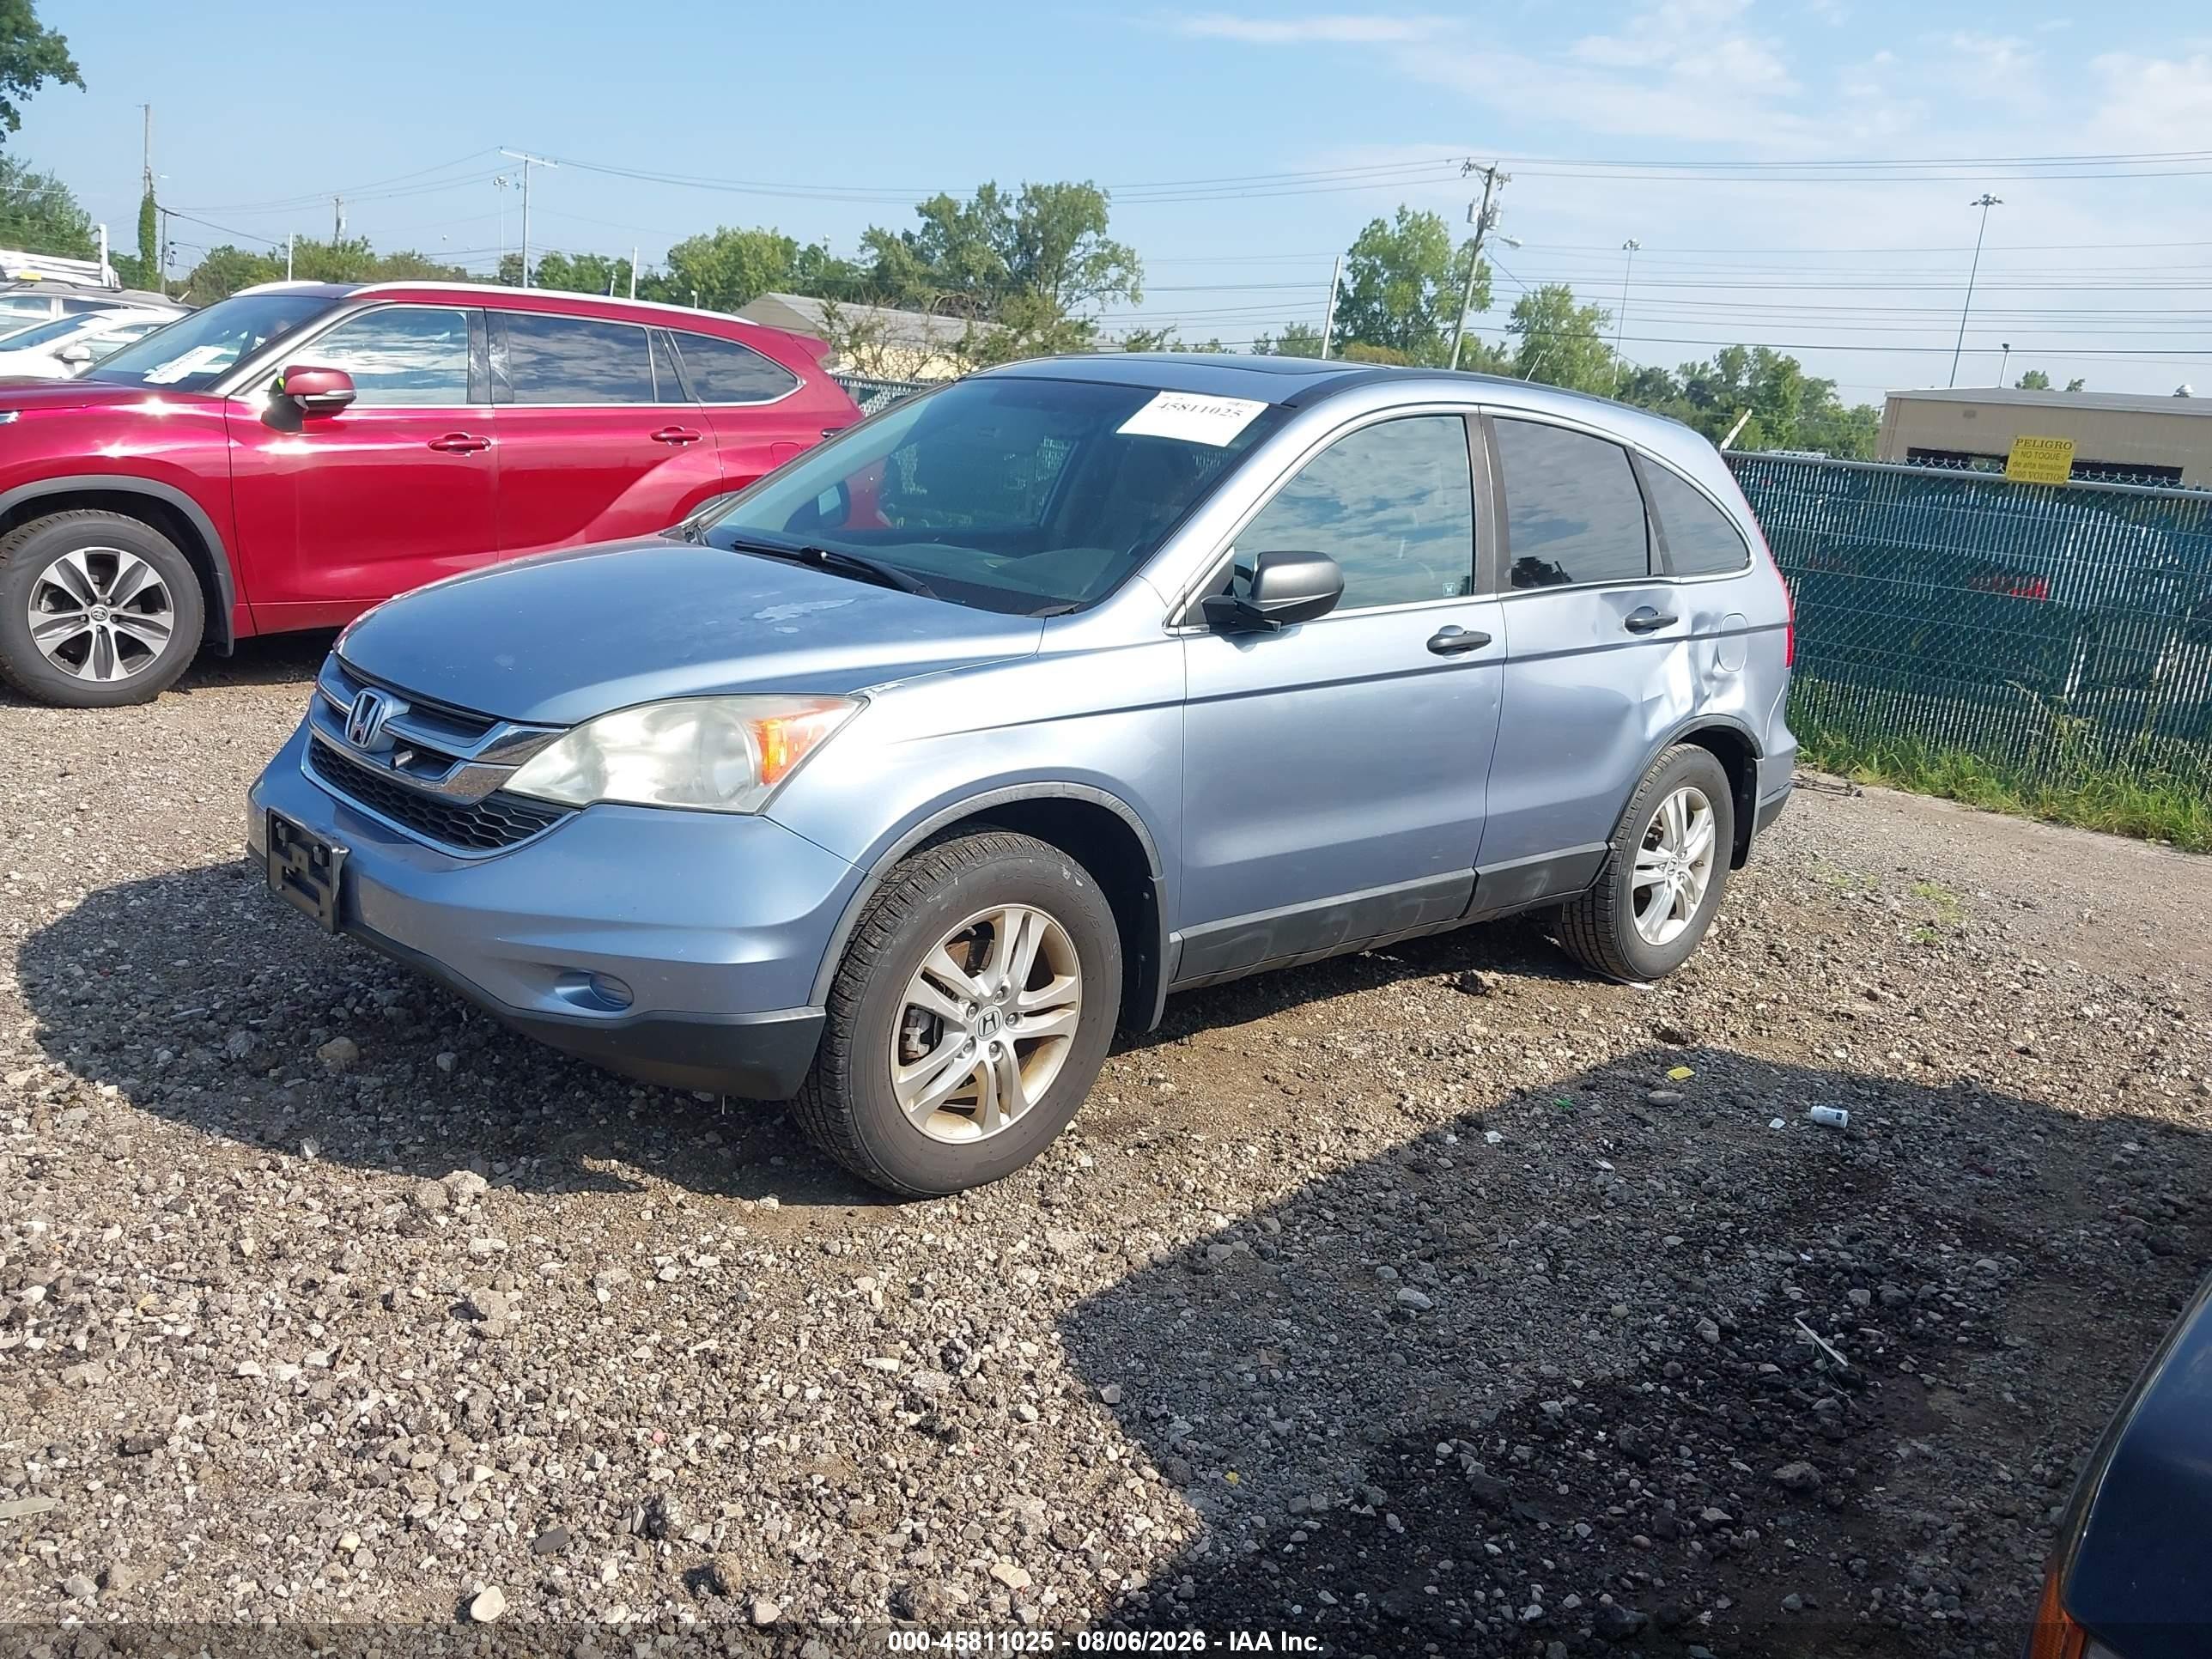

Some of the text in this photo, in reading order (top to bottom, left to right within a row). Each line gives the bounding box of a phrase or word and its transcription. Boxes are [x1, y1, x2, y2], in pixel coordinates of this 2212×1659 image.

[2015, 439, 2073, 451] PELIGRO
[2021, 451, 2061, 461] NO TOQUE
[2027, 471, 2065, 482] VOLTIOS
